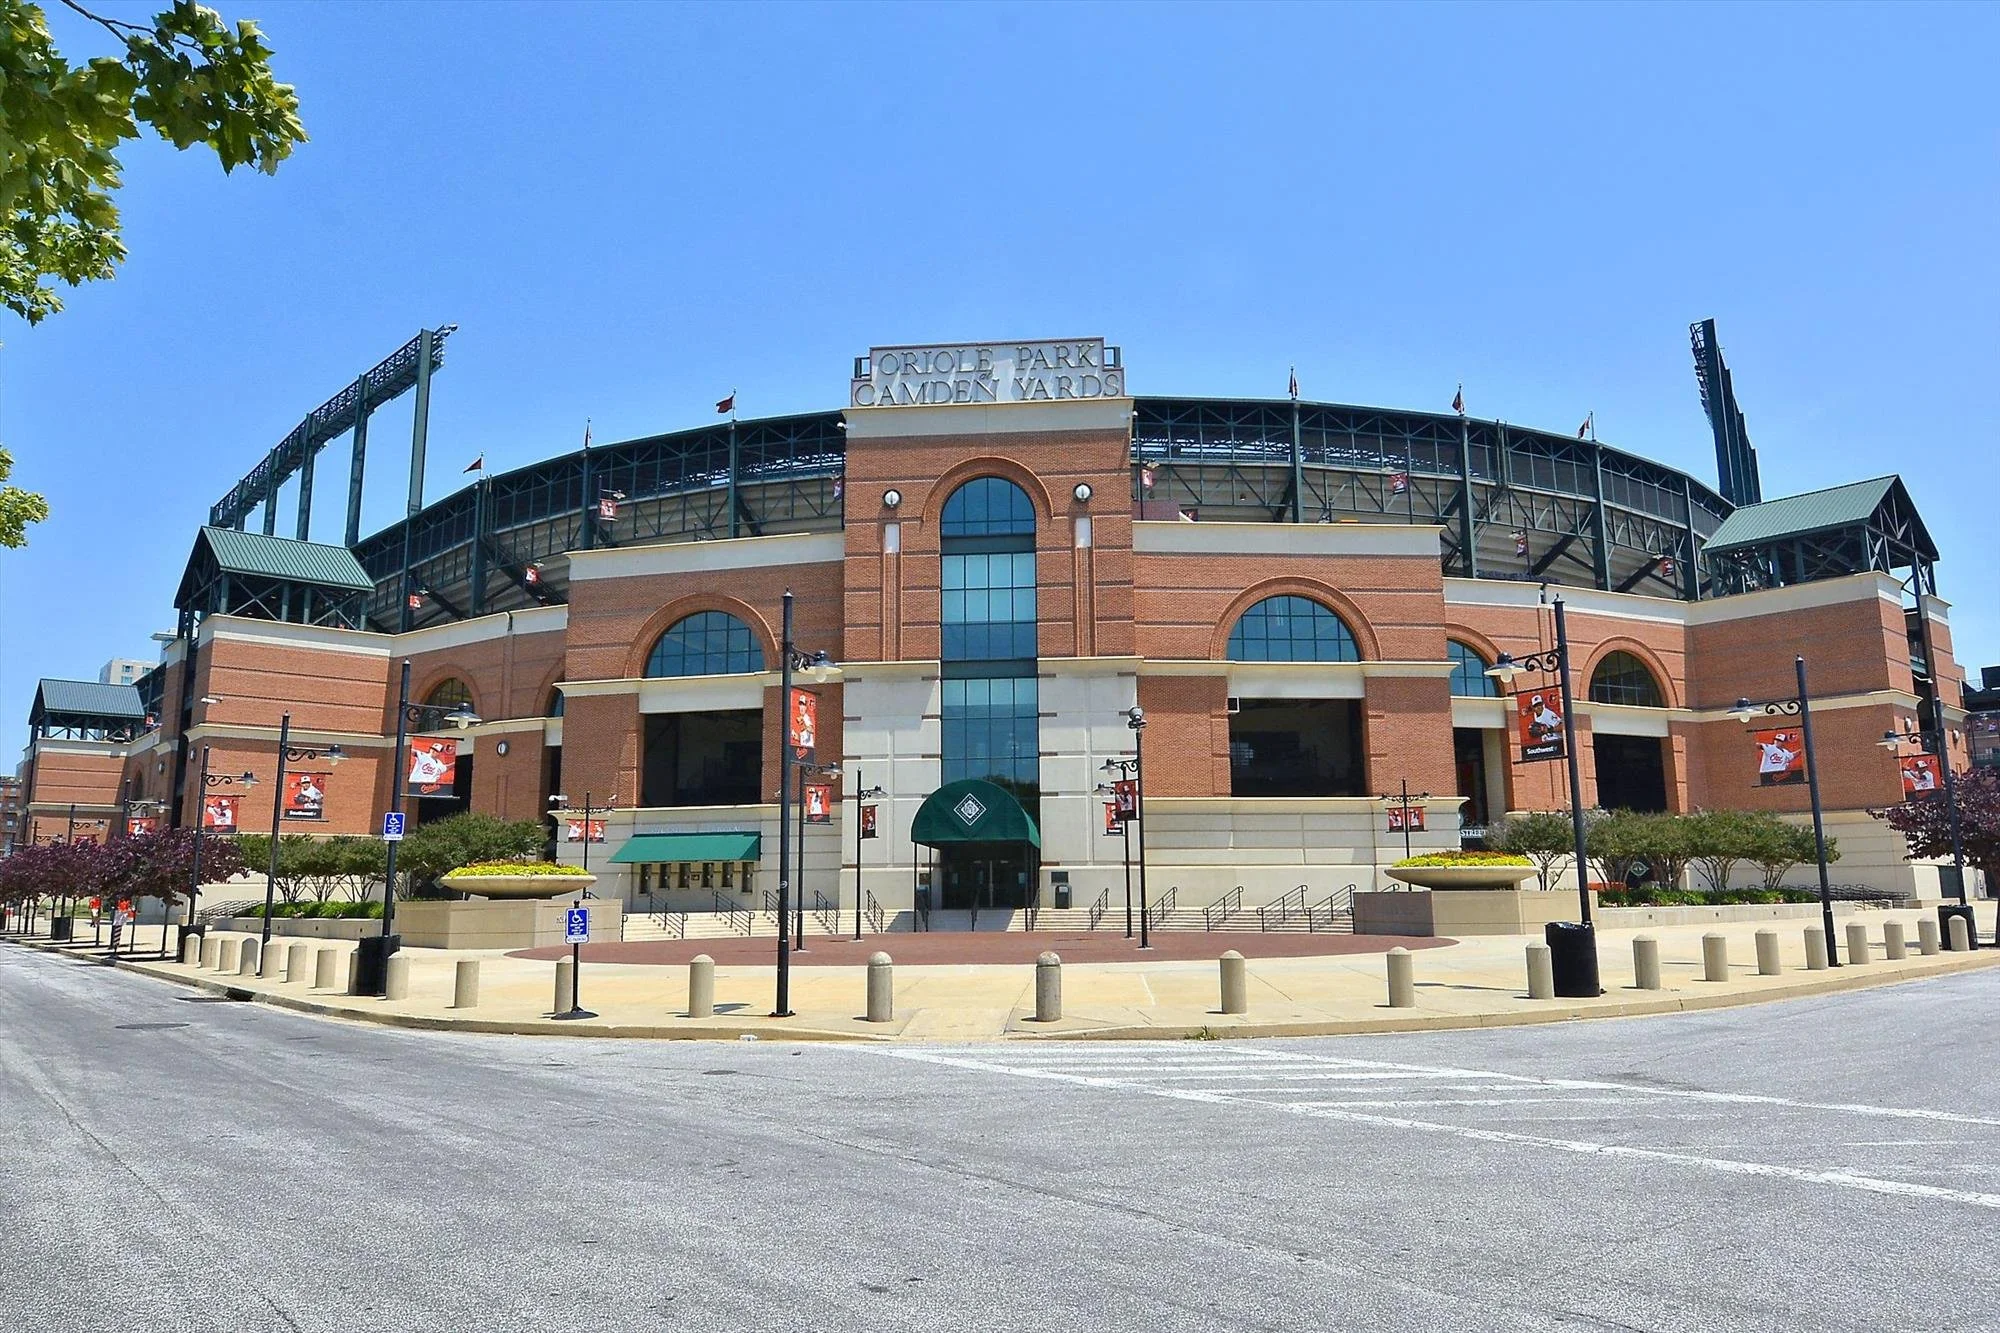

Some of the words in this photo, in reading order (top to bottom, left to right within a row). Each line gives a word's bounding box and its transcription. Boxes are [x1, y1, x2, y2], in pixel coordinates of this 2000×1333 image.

[880, 348, 994, 376] ORIOLE
[1015, 343, 1098, 371] PARK
[855, 378, 999, 406] CAMDEN
[1014, 373, 1119, 400] YARDS
[1526, 746, 1554, 755] Southwest
[1460, 829, 1486, 837] STREET
